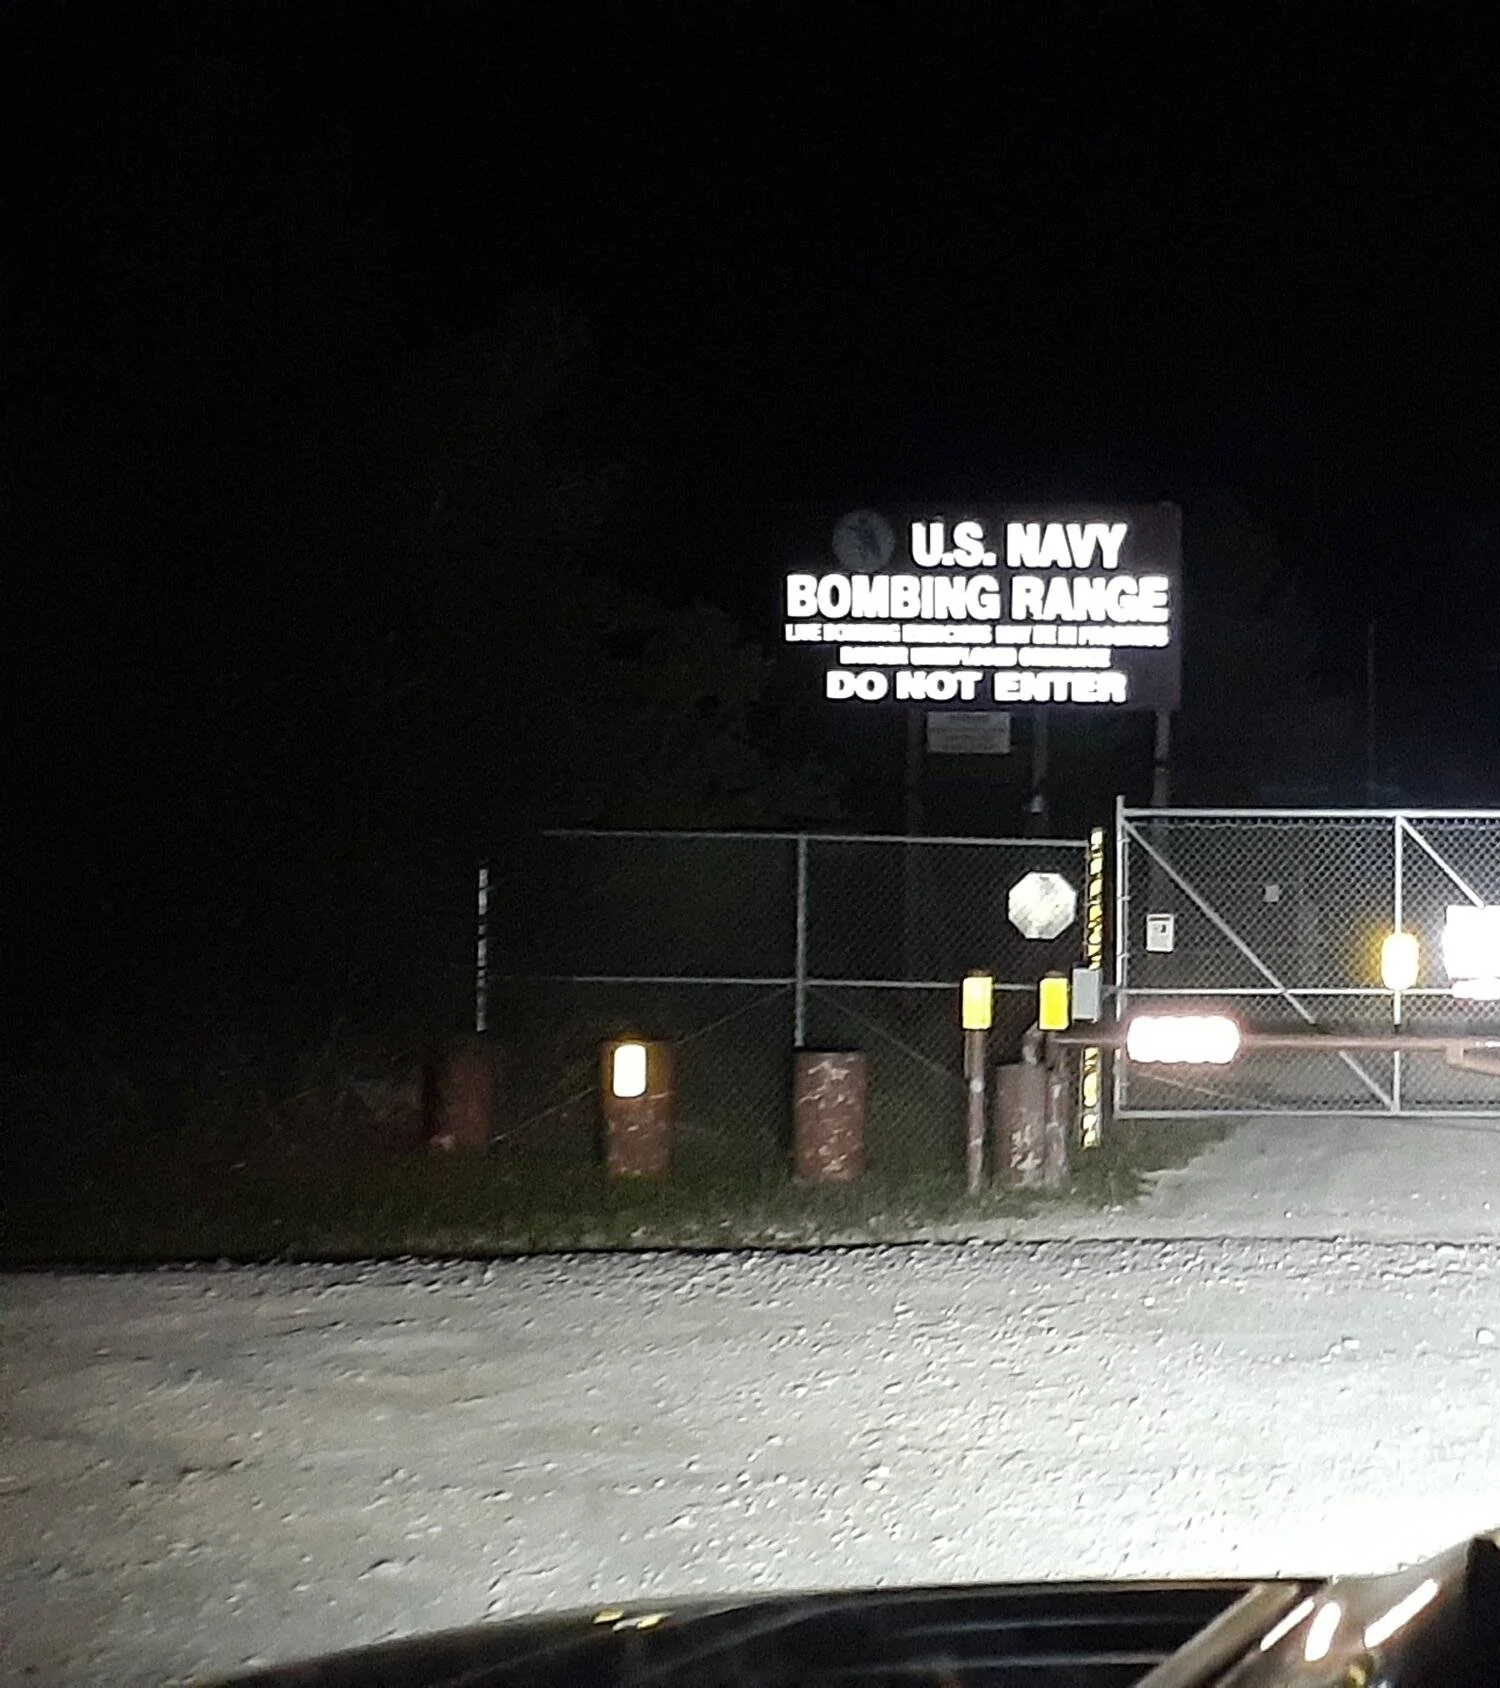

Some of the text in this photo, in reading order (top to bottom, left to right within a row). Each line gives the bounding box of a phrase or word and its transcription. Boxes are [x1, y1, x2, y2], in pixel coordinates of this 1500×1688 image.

[911, 521, 1128, 569] U.S. NAVY
[786, 573, 1170, 623] BOMBING RANGE
[785, 623, 823, 642] LE
[826, 670, 1128, 703] DO NOT ENTER
